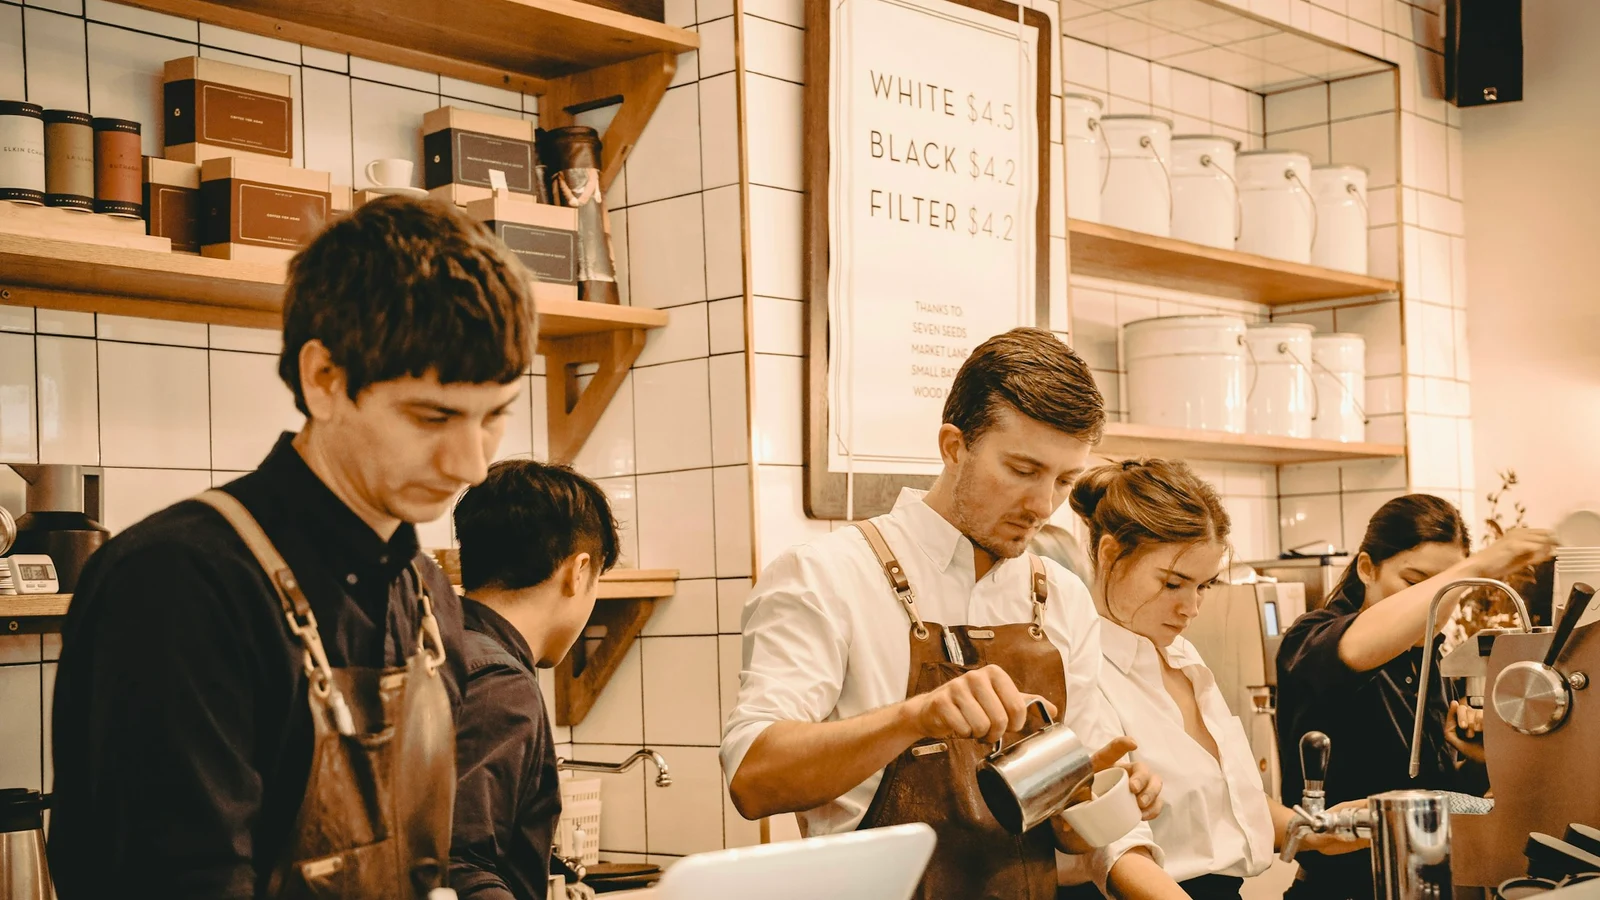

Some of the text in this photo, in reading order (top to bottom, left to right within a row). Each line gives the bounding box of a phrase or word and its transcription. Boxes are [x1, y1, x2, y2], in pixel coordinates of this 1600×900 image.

[870, 69, 1015, 131] WHITE $4.5
[870, 130, 1016, 187] BLACK $4.2
[870, 189, 1014, 242] FILTER $4.2
[915, 300, 948, 316] THANKS
[912, 321, 967, 339] SEVEN SEEDS
[911, 344, 968, 359] MARKET LANE
[911, 364, 939, 378] SMALL
[913, 386, 942, 399] WOOD
